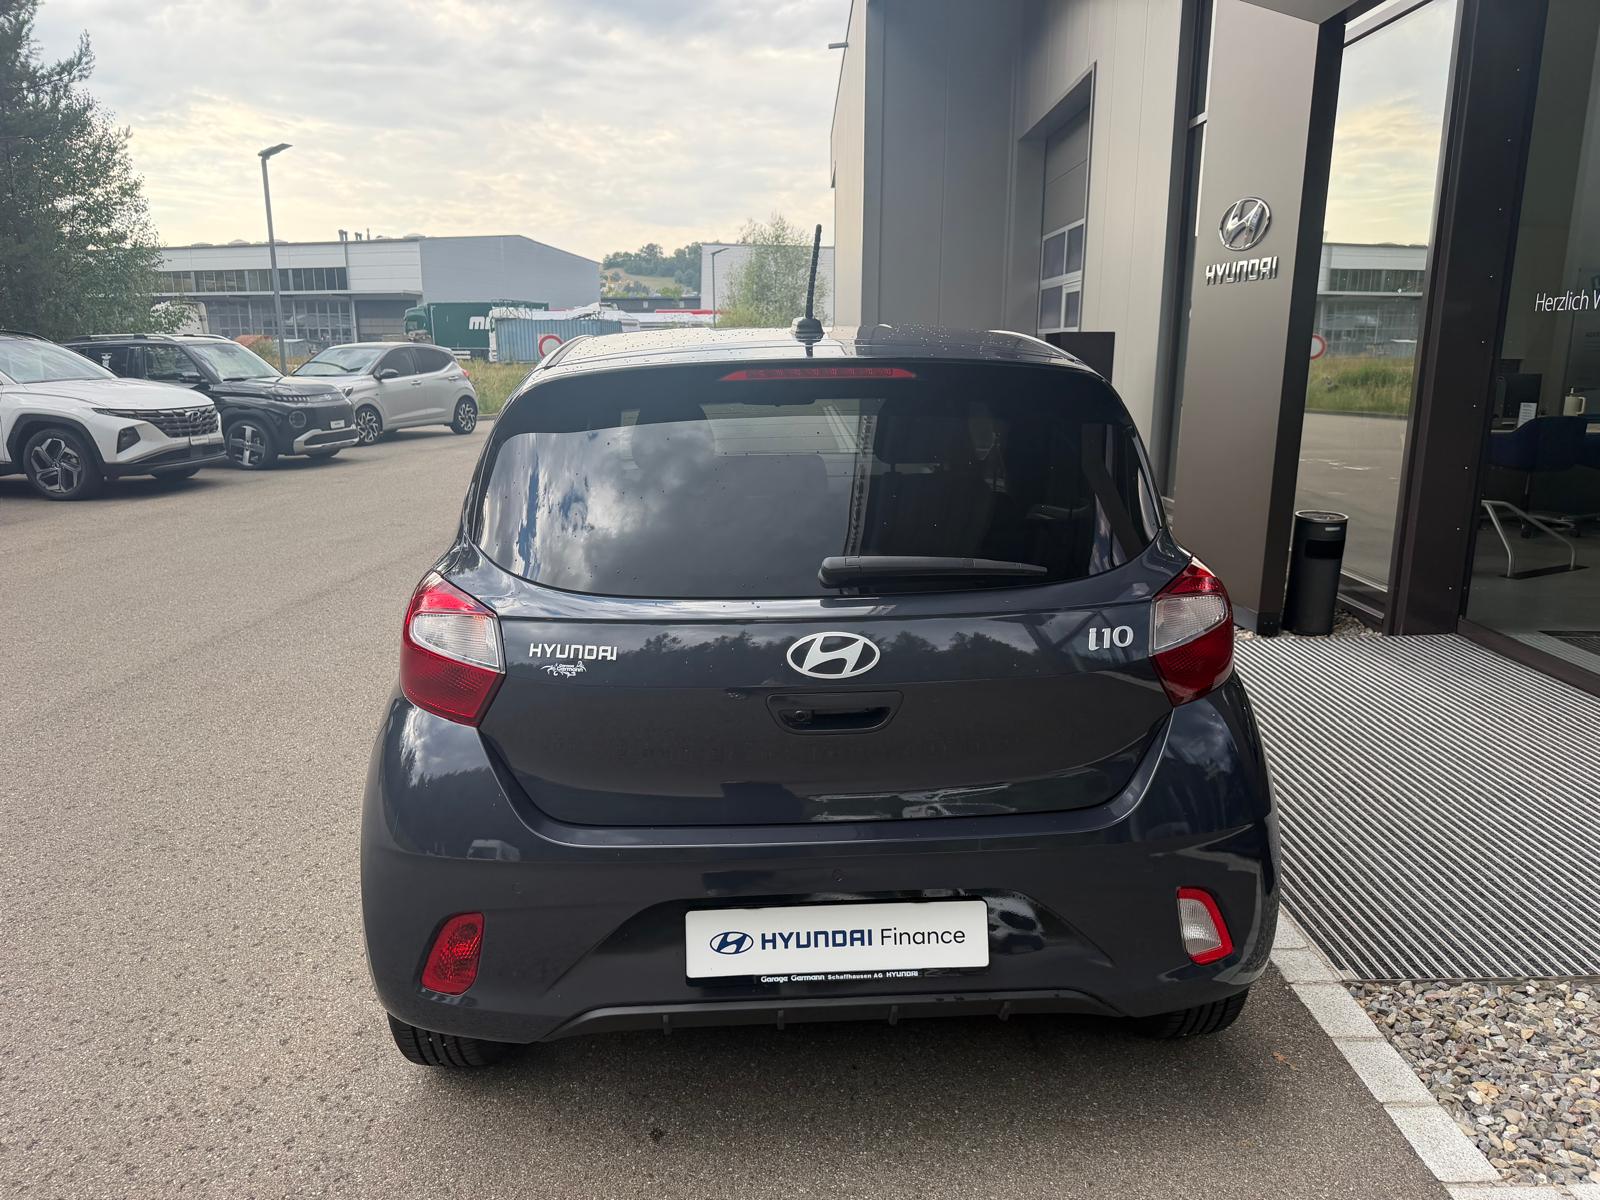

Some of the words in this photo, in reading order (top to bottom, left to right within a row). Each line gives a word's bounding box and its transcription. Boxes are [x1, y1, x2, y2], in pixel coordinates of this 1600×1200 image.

[1205, 256, 1278, 285] HYUNDAI
[1535, 289, 1589, 312] Herzlich
[1088, 625, 1134, 651] i10
[529, 643, 617, 660] HYUNDAI
[762, 929, 872, 950] HYUNDAI
[881, 928, 965, 946] Finance
